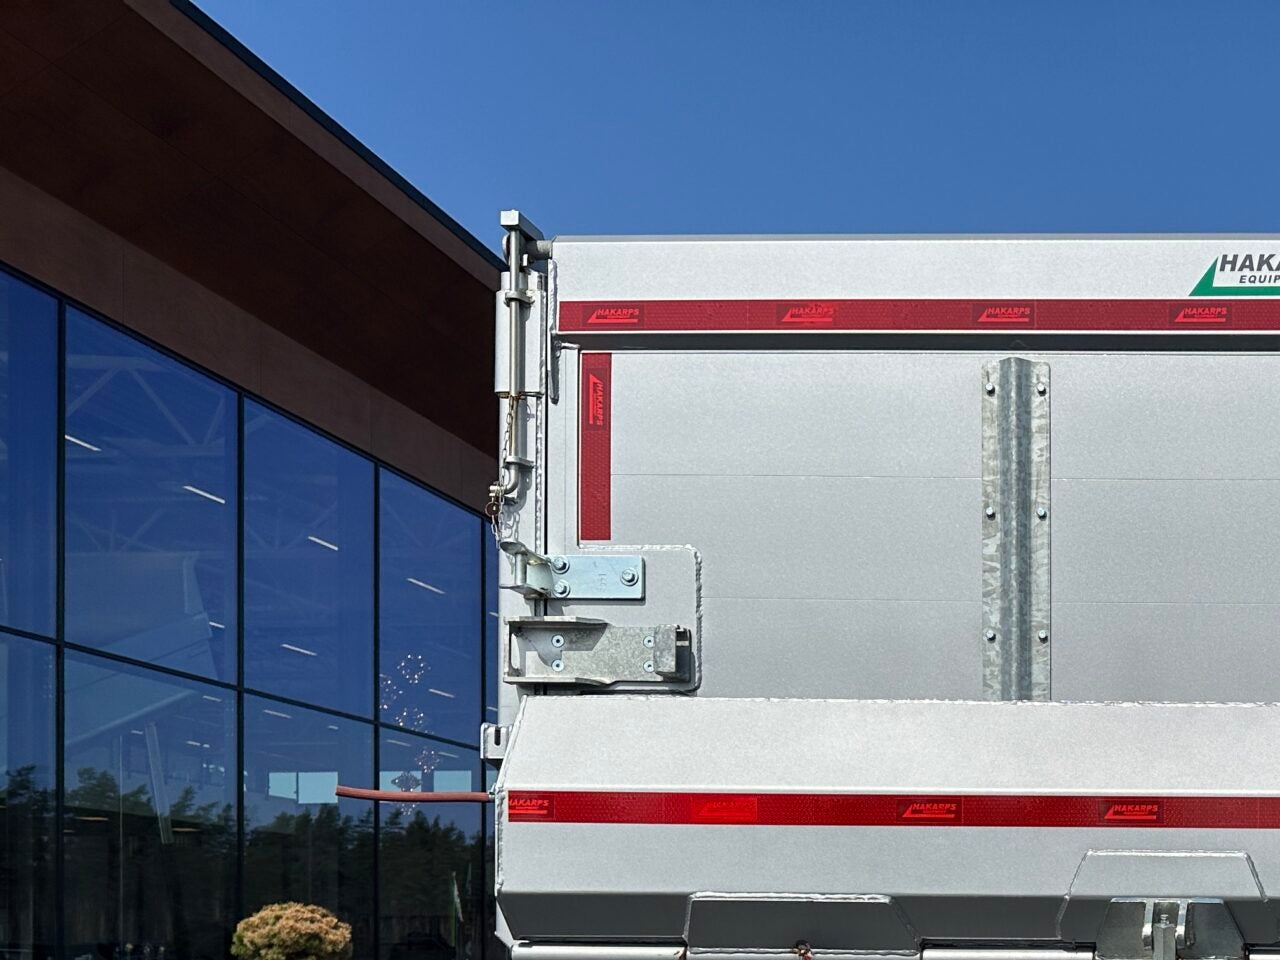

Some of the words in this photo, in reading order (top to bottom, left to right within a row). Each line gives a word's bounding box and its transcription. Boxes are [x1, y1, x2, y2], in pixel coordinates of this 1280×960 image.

[597, 308, 640, 316] HAKARPS
[988, 307, 1030, 315] HAKARPS
[1184, 307, 1227, 315] HAKARPS
[912, 803, 957, 811] HAKARPS
[1114, 804, 1158, 812] HAKARPS
